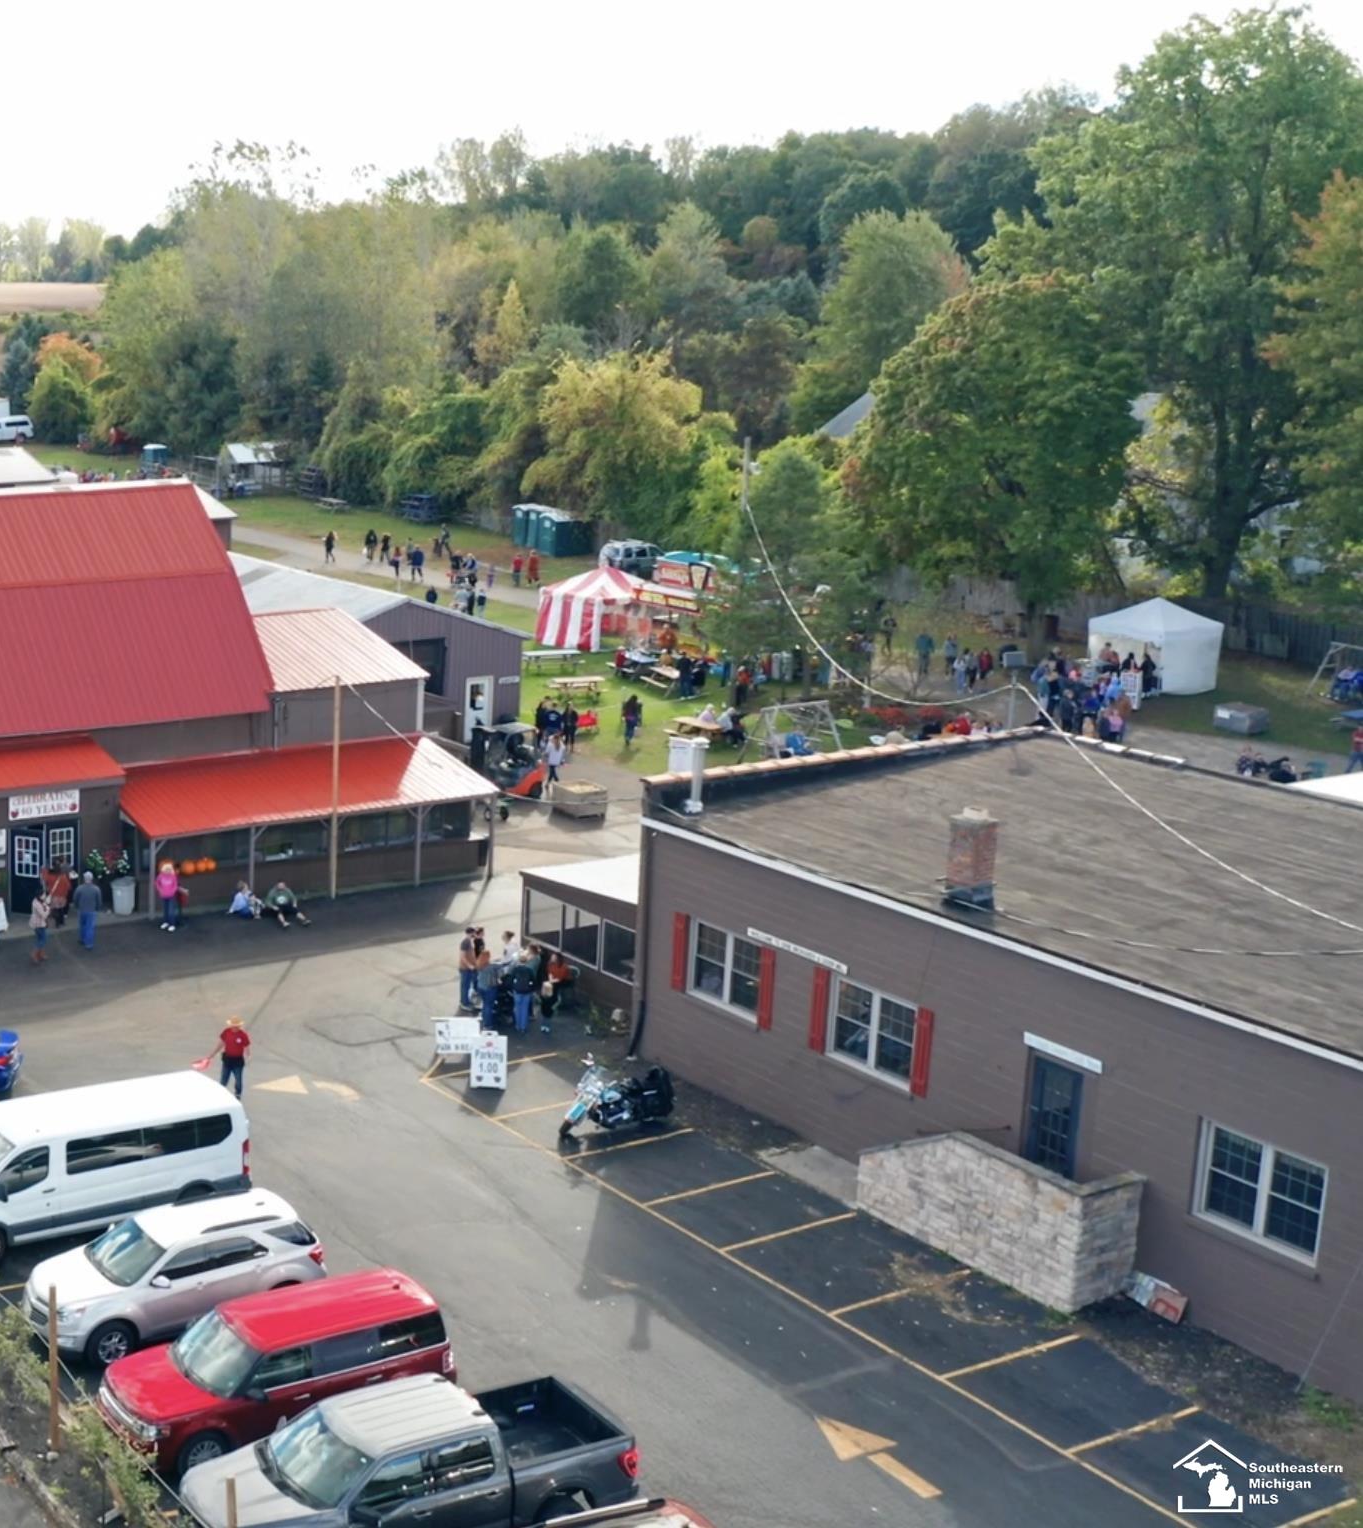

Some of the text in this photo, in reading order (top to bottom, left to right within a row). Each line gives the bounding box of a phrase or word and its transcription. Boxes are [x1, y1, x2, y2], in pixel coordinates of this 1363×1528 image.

[12, 791, 76, 806] CELEBRATING
[36, 802, 69, 815] YEARS
[475, 1049, 504, 1063] Parking
[479, 1062, 498, 1074] 1.00
